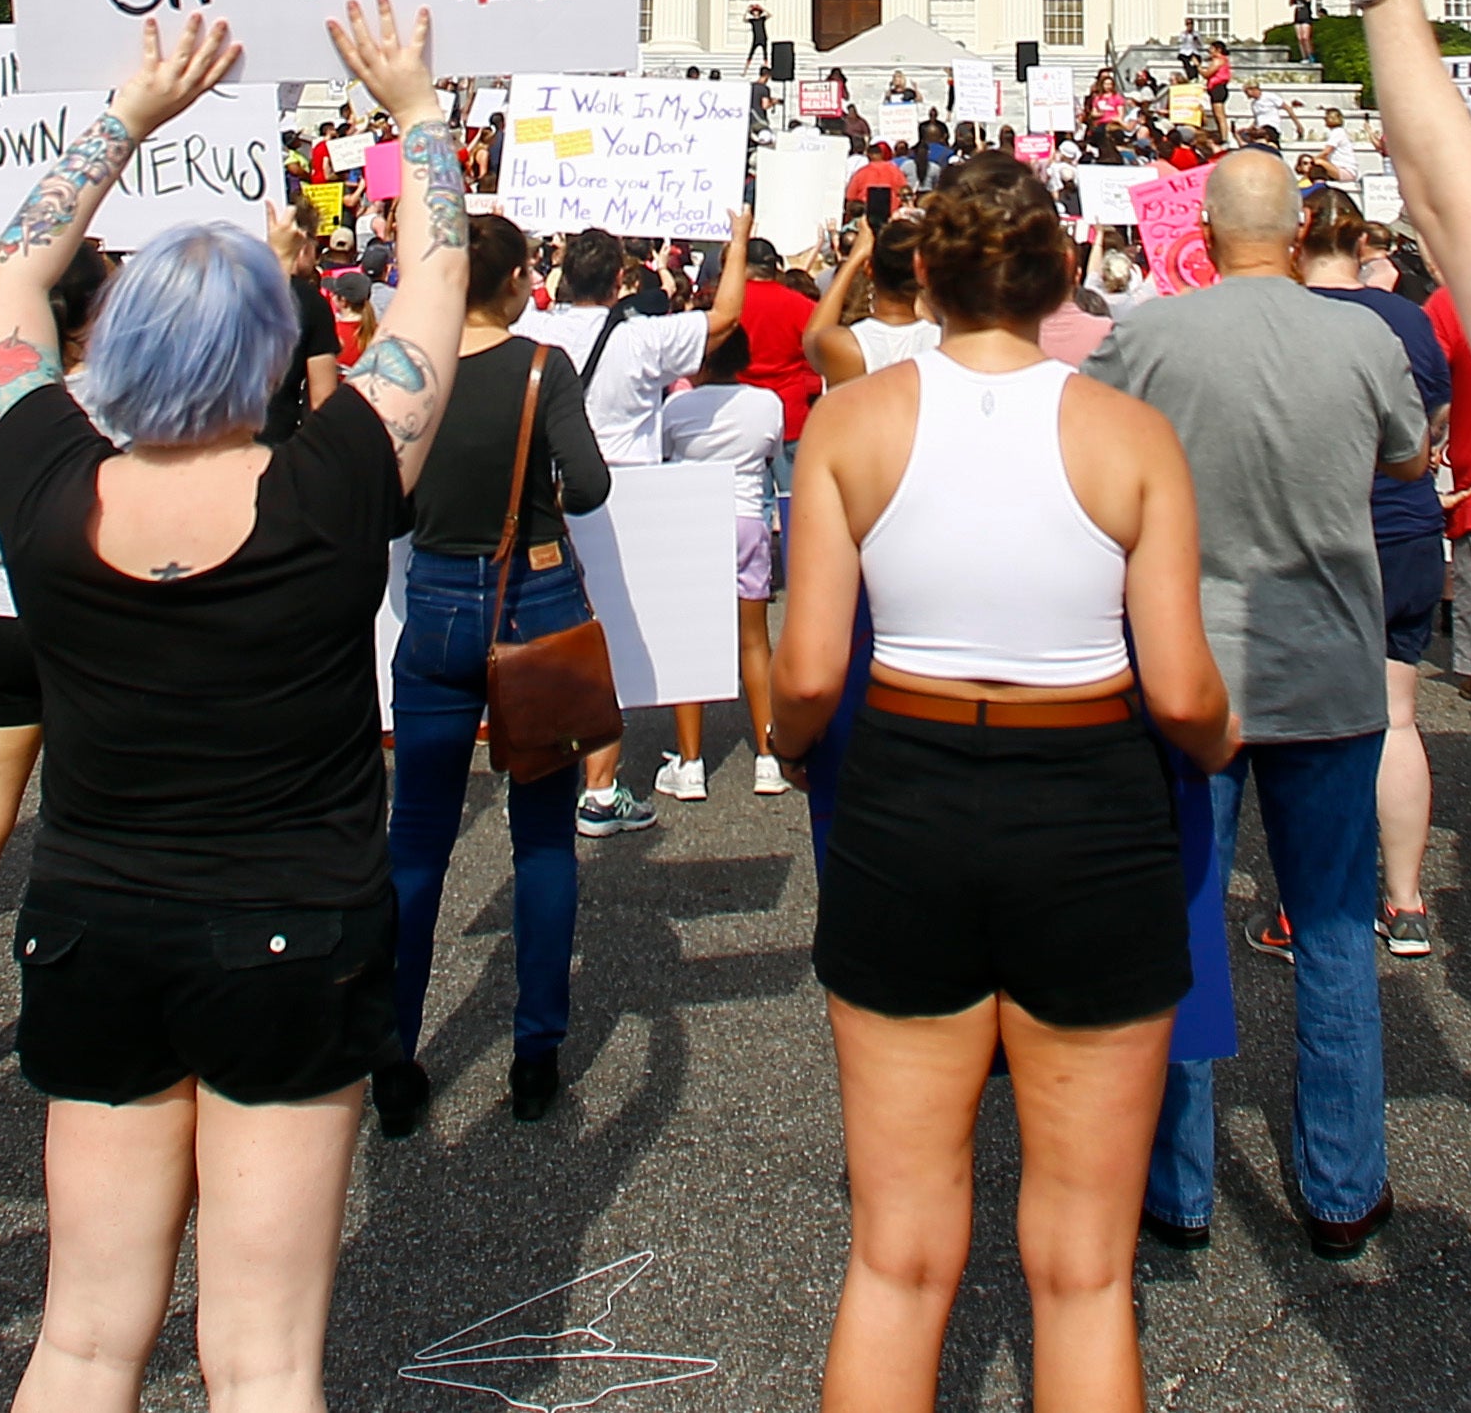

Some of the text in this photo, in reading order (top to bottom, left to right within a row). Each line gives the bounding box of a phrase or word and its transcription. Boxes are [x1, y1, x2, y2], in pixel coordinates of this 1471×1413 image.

[537, 87, 744, 130] I Walk In My Shoes
[601, 127, 640, 157] You
[511, 158, 713, 198] How Dare you Try To
[507, 193, 712, 230] Tell Me My Medical
